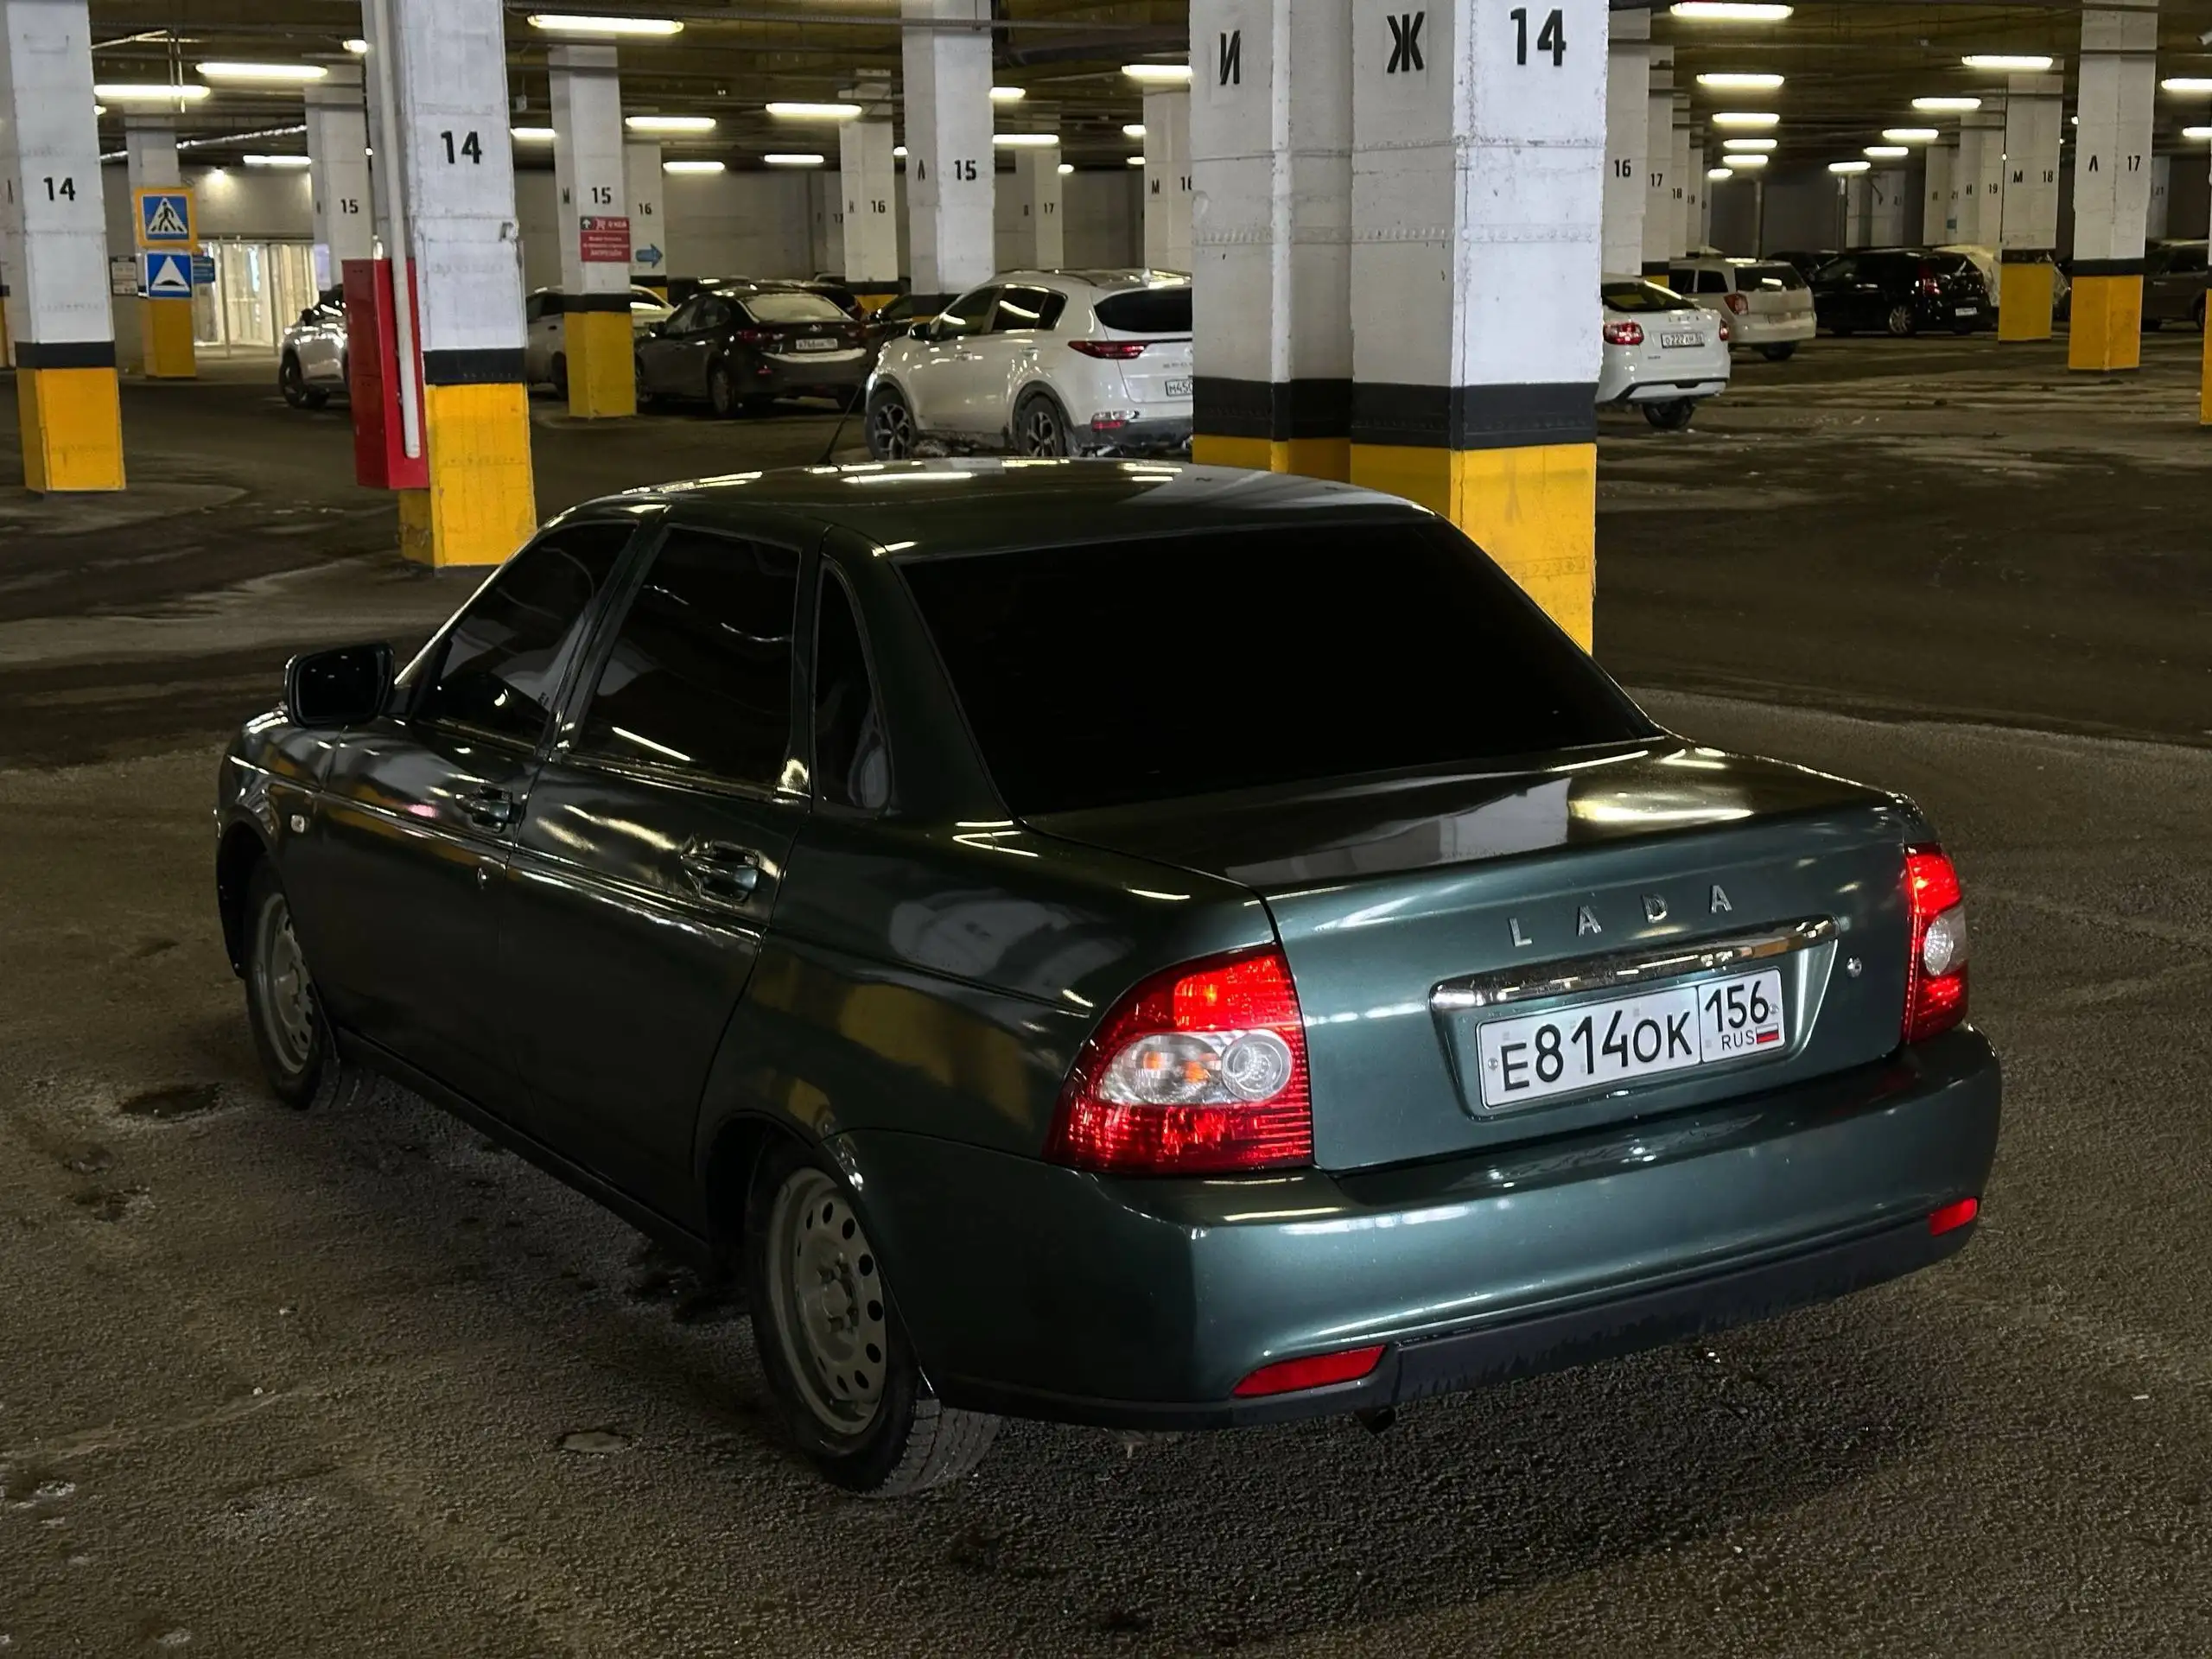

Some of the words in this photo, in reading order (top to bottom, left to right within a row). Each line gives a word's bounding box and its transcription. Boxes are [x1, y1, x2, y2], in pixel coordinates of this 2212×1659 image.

[1387, 11, 1425, 73] Ж
[1510, 8, 1567, 67] 14
[1220, 30, 1241, 86] И
[441, 130, 482, 164] 14
[954, 160, 976, 181] 15
[1614, 159, 1631, 178] 16
[2127, 156, 2141, 172] 17
[1651, 173, 1662, 187] 17
[2043, 170, 2054, 183] 18
[43, 176, 76, 201] 14
[592, 187, 612, 204] 15
[1672, 188, 1682, 199] 18
[1989, 183, 1999, 194] 19
[340, 198, 359, 214] 15
[639, 203, 652, 215] 16
[871, 200, 886, 213] 16
[1044, 202, 1054, 213] 17
[1507, 883, 1732, 948] LADA
[1704, 980, 1770, 1033] 156
[1721, 1031, 1756, 1052] RUS
